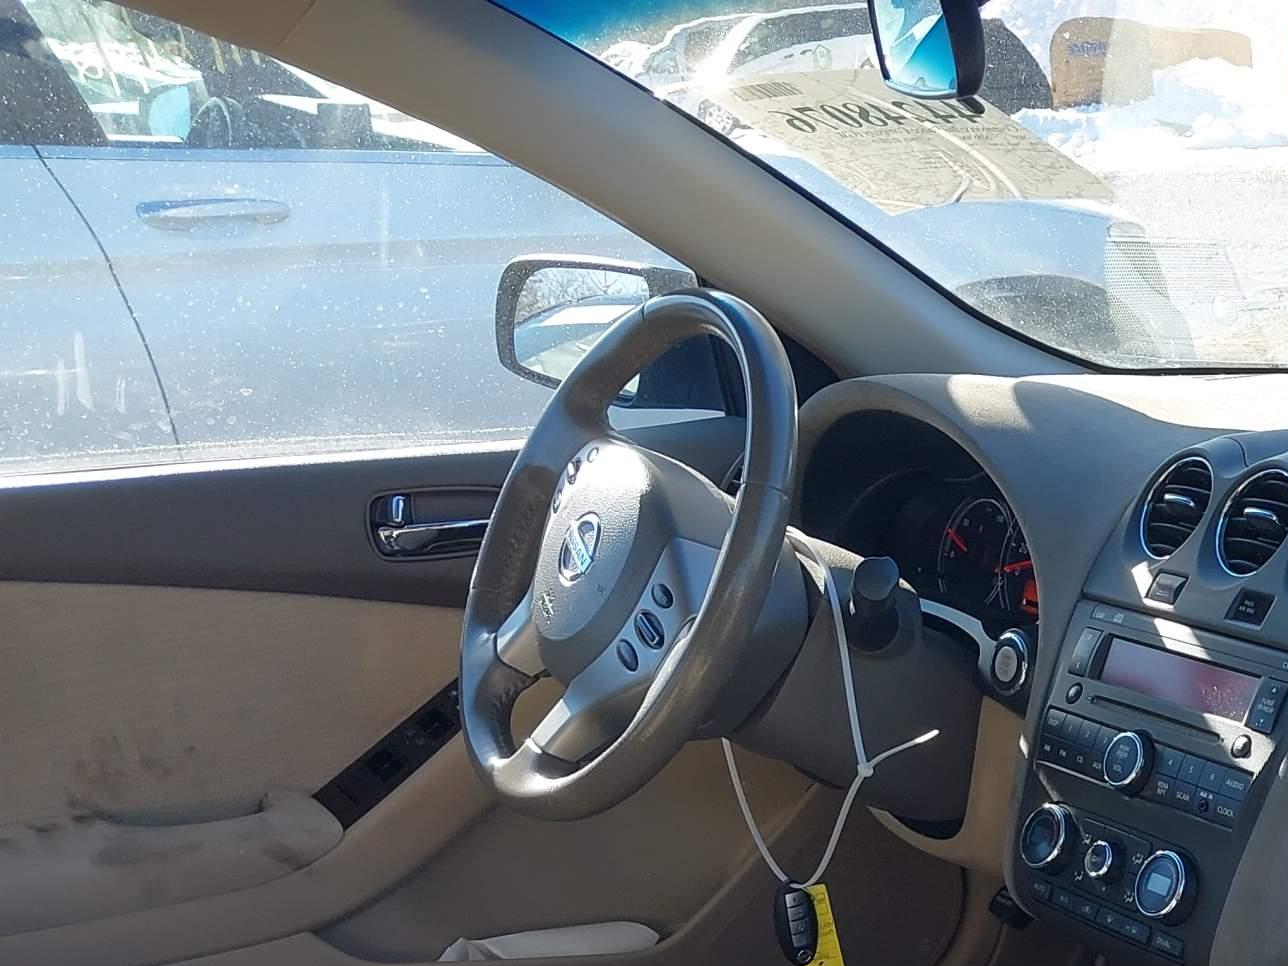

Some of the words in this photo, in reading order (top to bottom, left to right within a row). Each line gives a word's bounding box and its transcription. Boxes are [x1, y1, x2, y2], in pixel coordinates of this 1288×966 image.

[1226, 778, 1245, 791] AUDIO
[1176, 791, 1191, 802] SCAN
[1217, 805, 1234, 818] CLOCK
